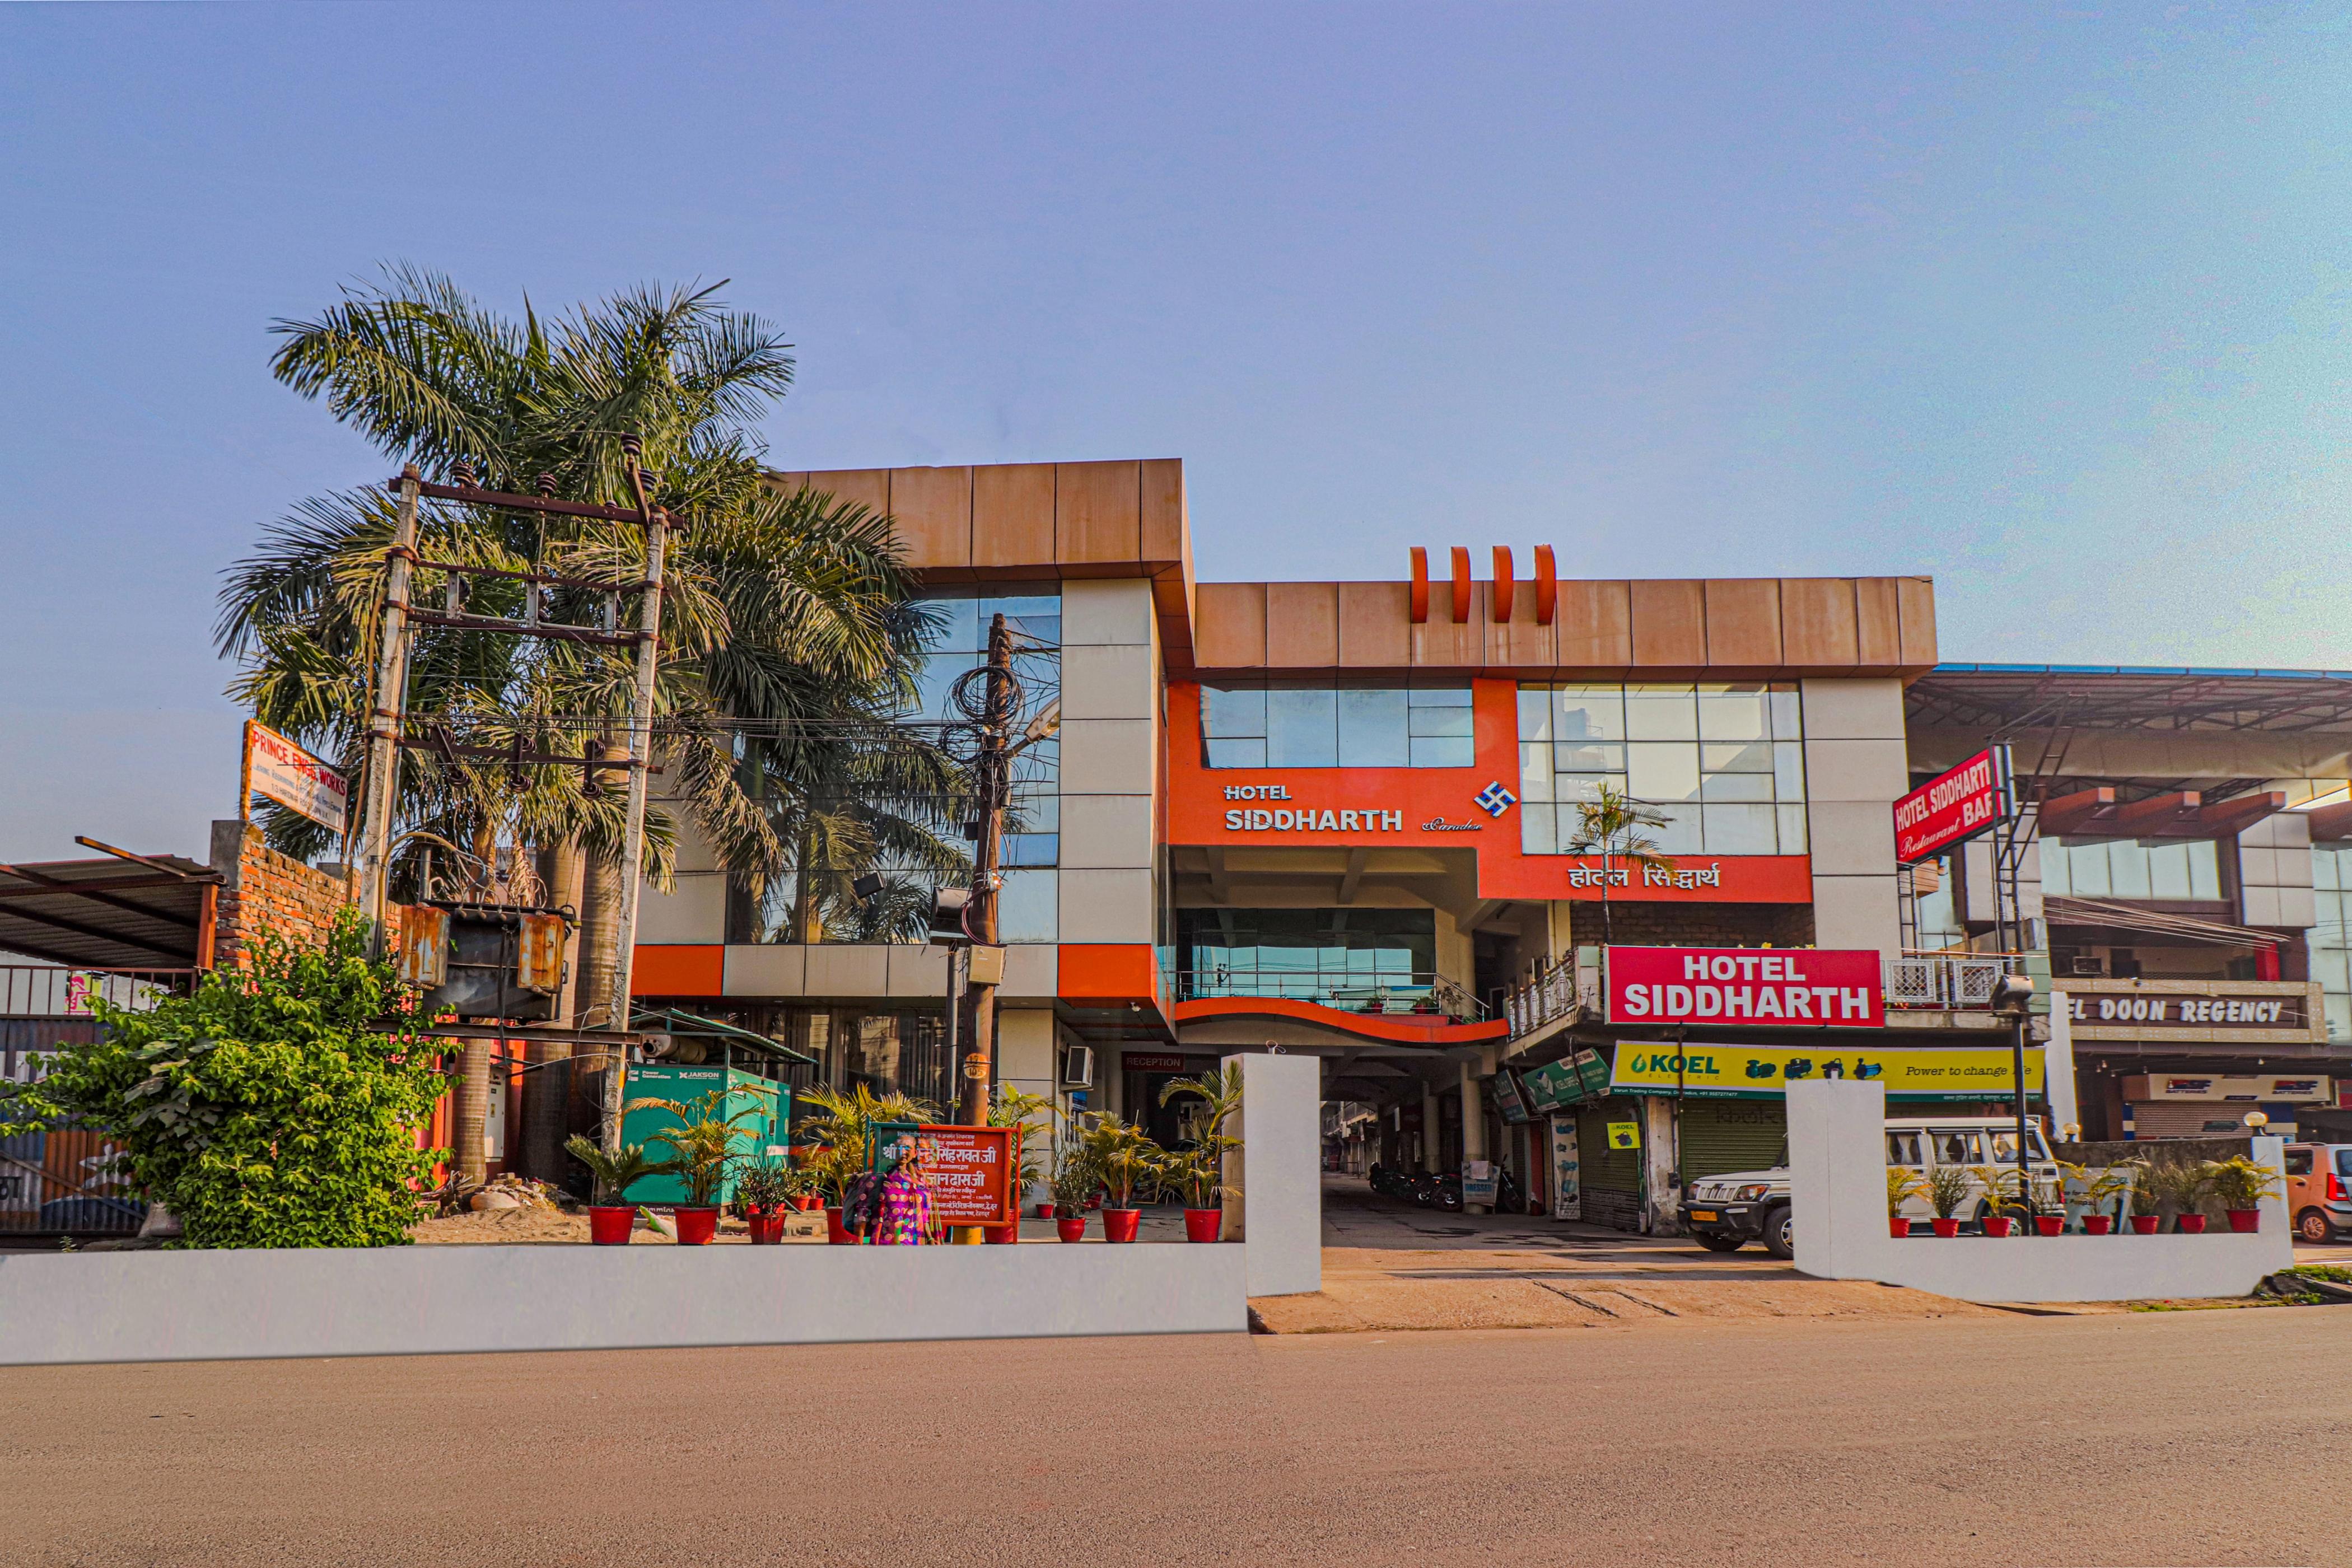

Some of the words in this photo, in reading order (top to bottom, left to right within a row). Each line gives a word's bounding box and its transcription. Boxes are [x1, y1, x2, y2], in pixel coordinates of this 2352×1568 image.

[253, 731, 288, 765] PRINCE
[319, 767, 346, 796] WORKS
[1225, 785, 1291, 799] HOTEL
[1225, 809, 1402, 830] SIDDHARTH
[1422, 817, 1482, 830] Paradise
[1896, 794, 1929, 832] HOTEL
[1900, 816, 1961, 857] Restaurant
[1568, 862, 1630, 888] होटल
[1643, 862, 1720, 889] सिद्धार्थ
[1684, 955, 1806, 981] HOTEL
[1625, 984, 1870, 1019] SIDDHARTH
[2098, 999, 2167, 1021] DOON
[2180, 1000, 2282, 1022] REGENCY
[1127, 1057, 1180, 1066] RECEPTION
[1650, 1055, 1720, 1074] KOEL
[1906, 1067, 1944, 1075] Power
[1964, 1066, 2007, 1077] change
[883, 1143, 897, 1160] श्री
[956, 1149, 980, 1163] रावत
[981, 1146, 996, 1163] जी
[950, 1173, 971, 1187] दास
[971, 1170, 986, 1187] जी
